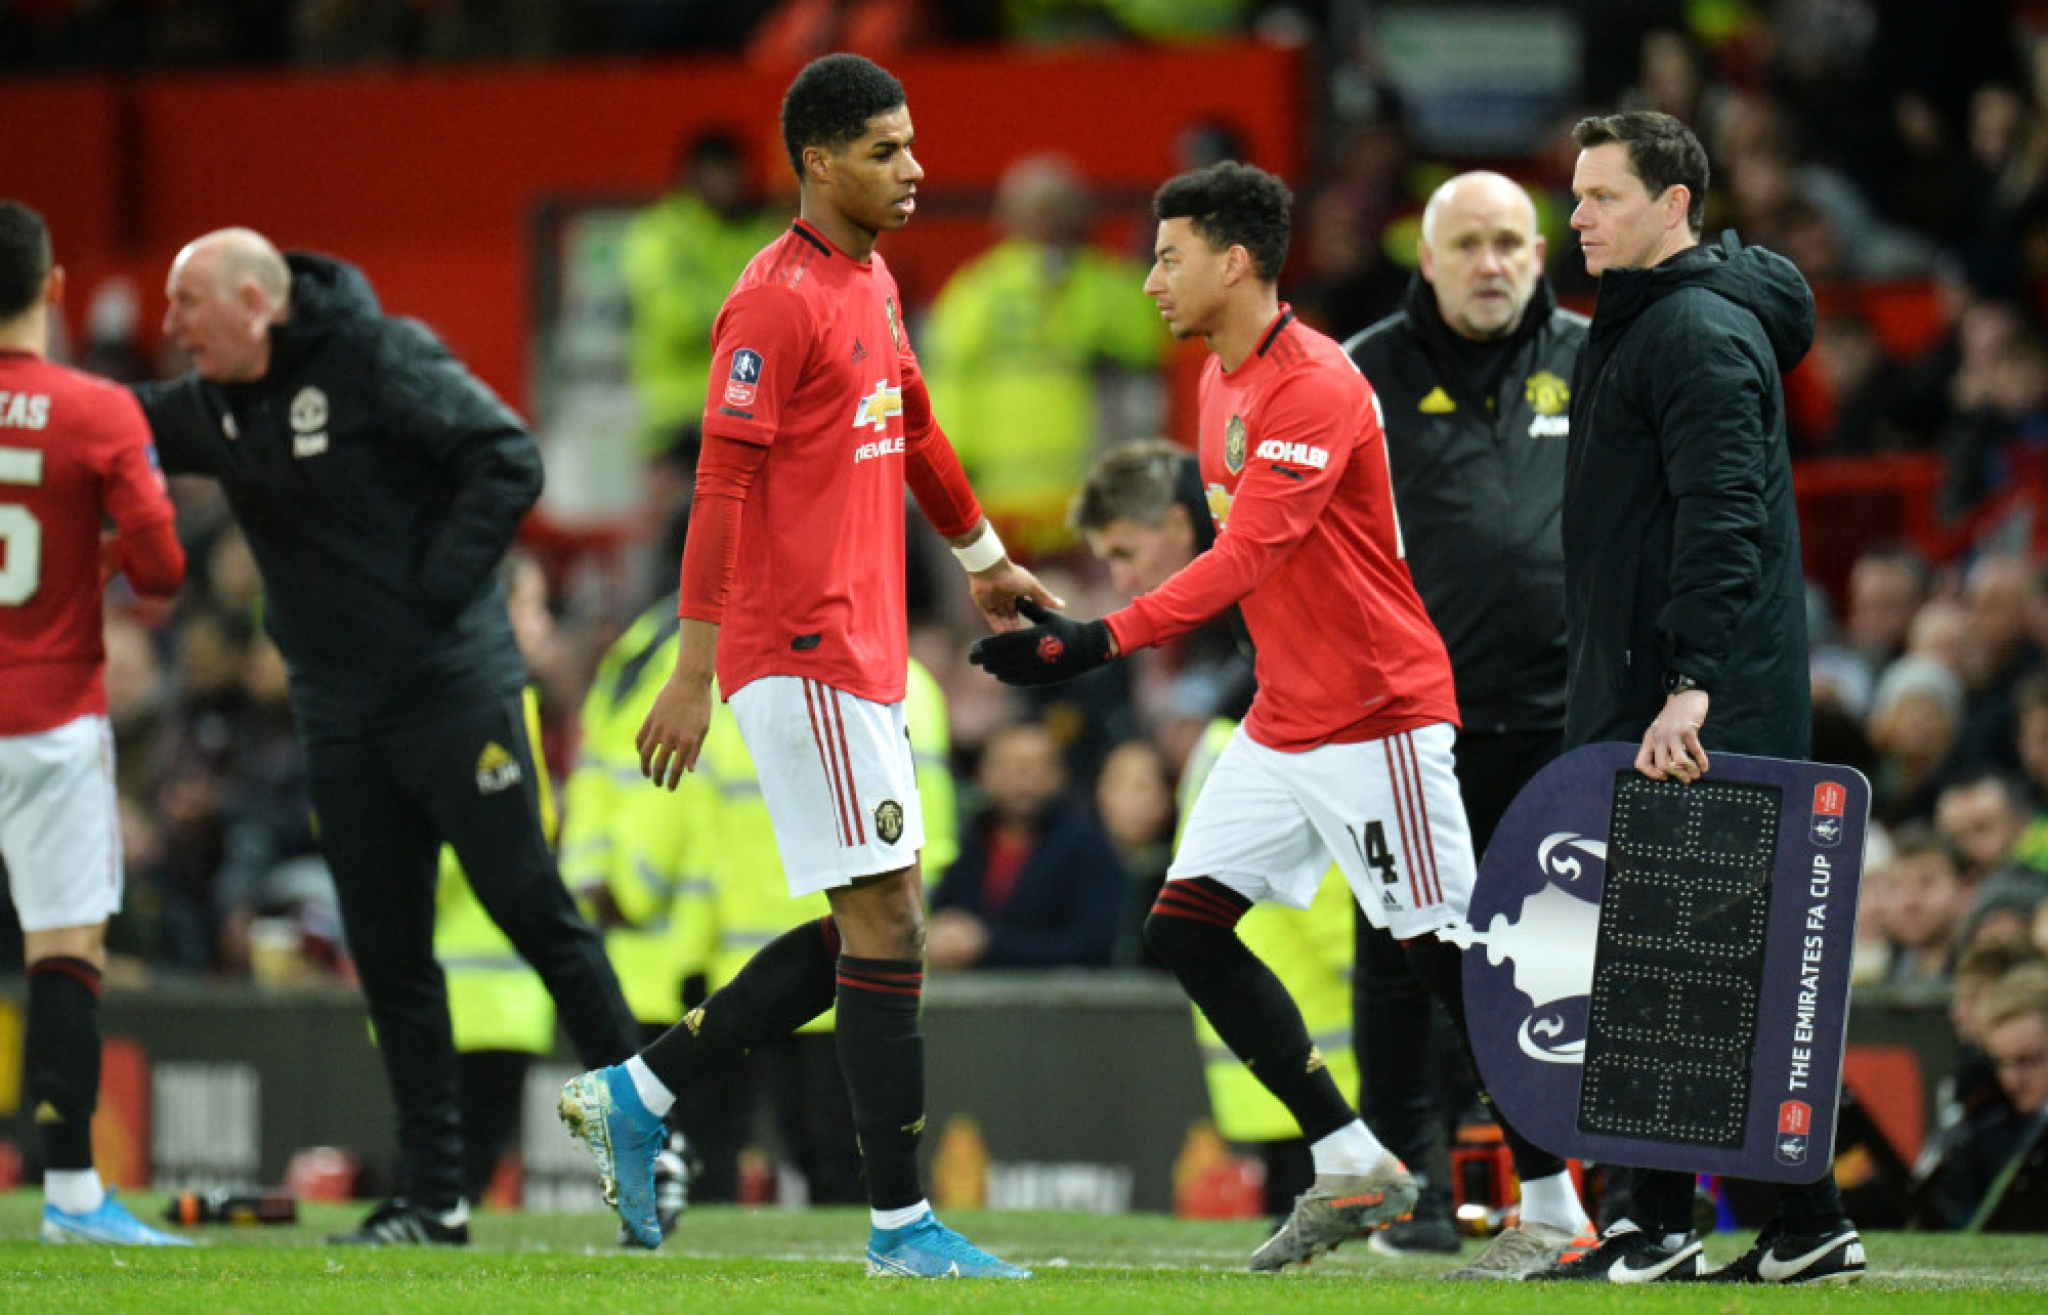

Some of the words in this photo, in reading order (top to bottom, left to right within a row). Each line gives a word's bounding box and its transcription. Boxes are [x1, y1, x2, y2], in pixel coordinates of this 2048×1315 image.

[1256, 439, 1328, 469] KOHLER
[1810, 853, 1831, 897] CUP
[1806, 904, 1827, 930] FA
[1794, 935, 1824, 1041] EMIRATES
[1788, 1047, 1811, 1091] THE
